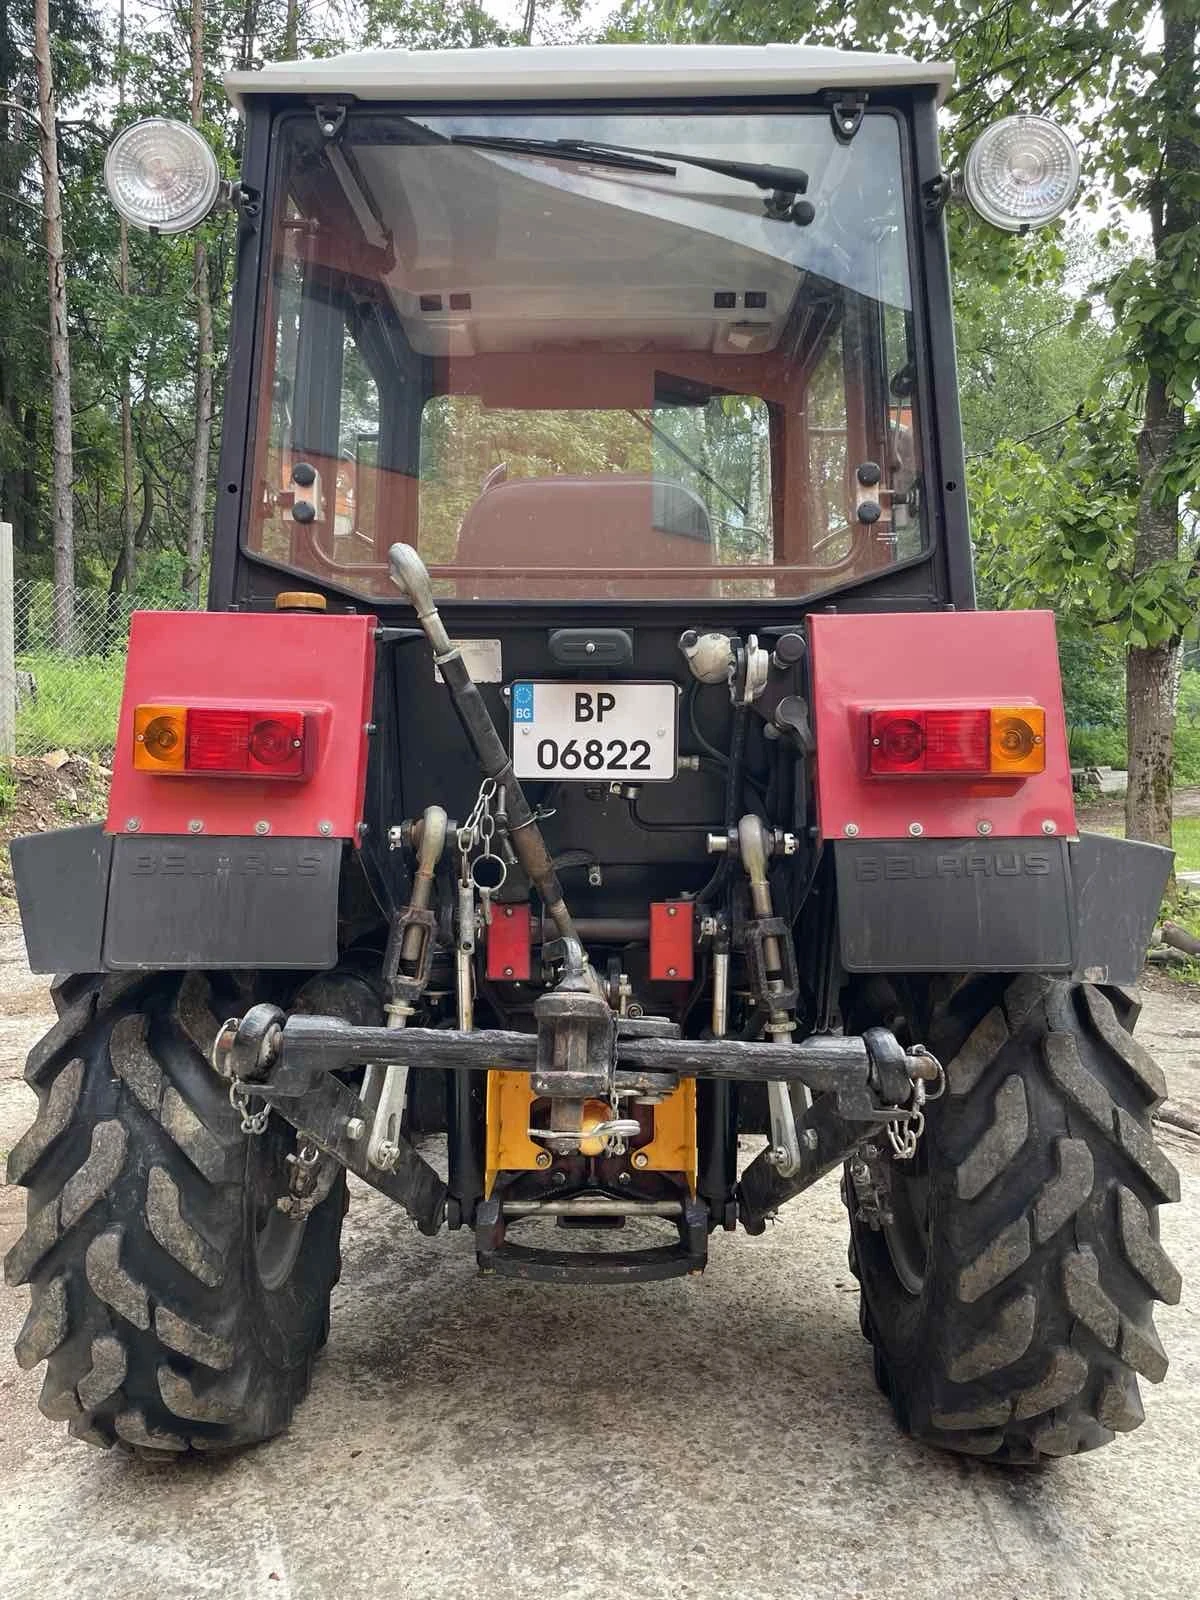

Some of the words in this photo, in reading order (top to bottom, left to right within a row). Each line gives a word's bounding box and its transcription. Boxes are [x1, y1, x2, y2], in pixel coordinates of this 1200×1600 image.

[516, 708, 531, 719] BG
[575, 692, 616, 722] BP
[537, 738, 651, 770] 06822
[855, 851, 1051, 882] BELARUS
